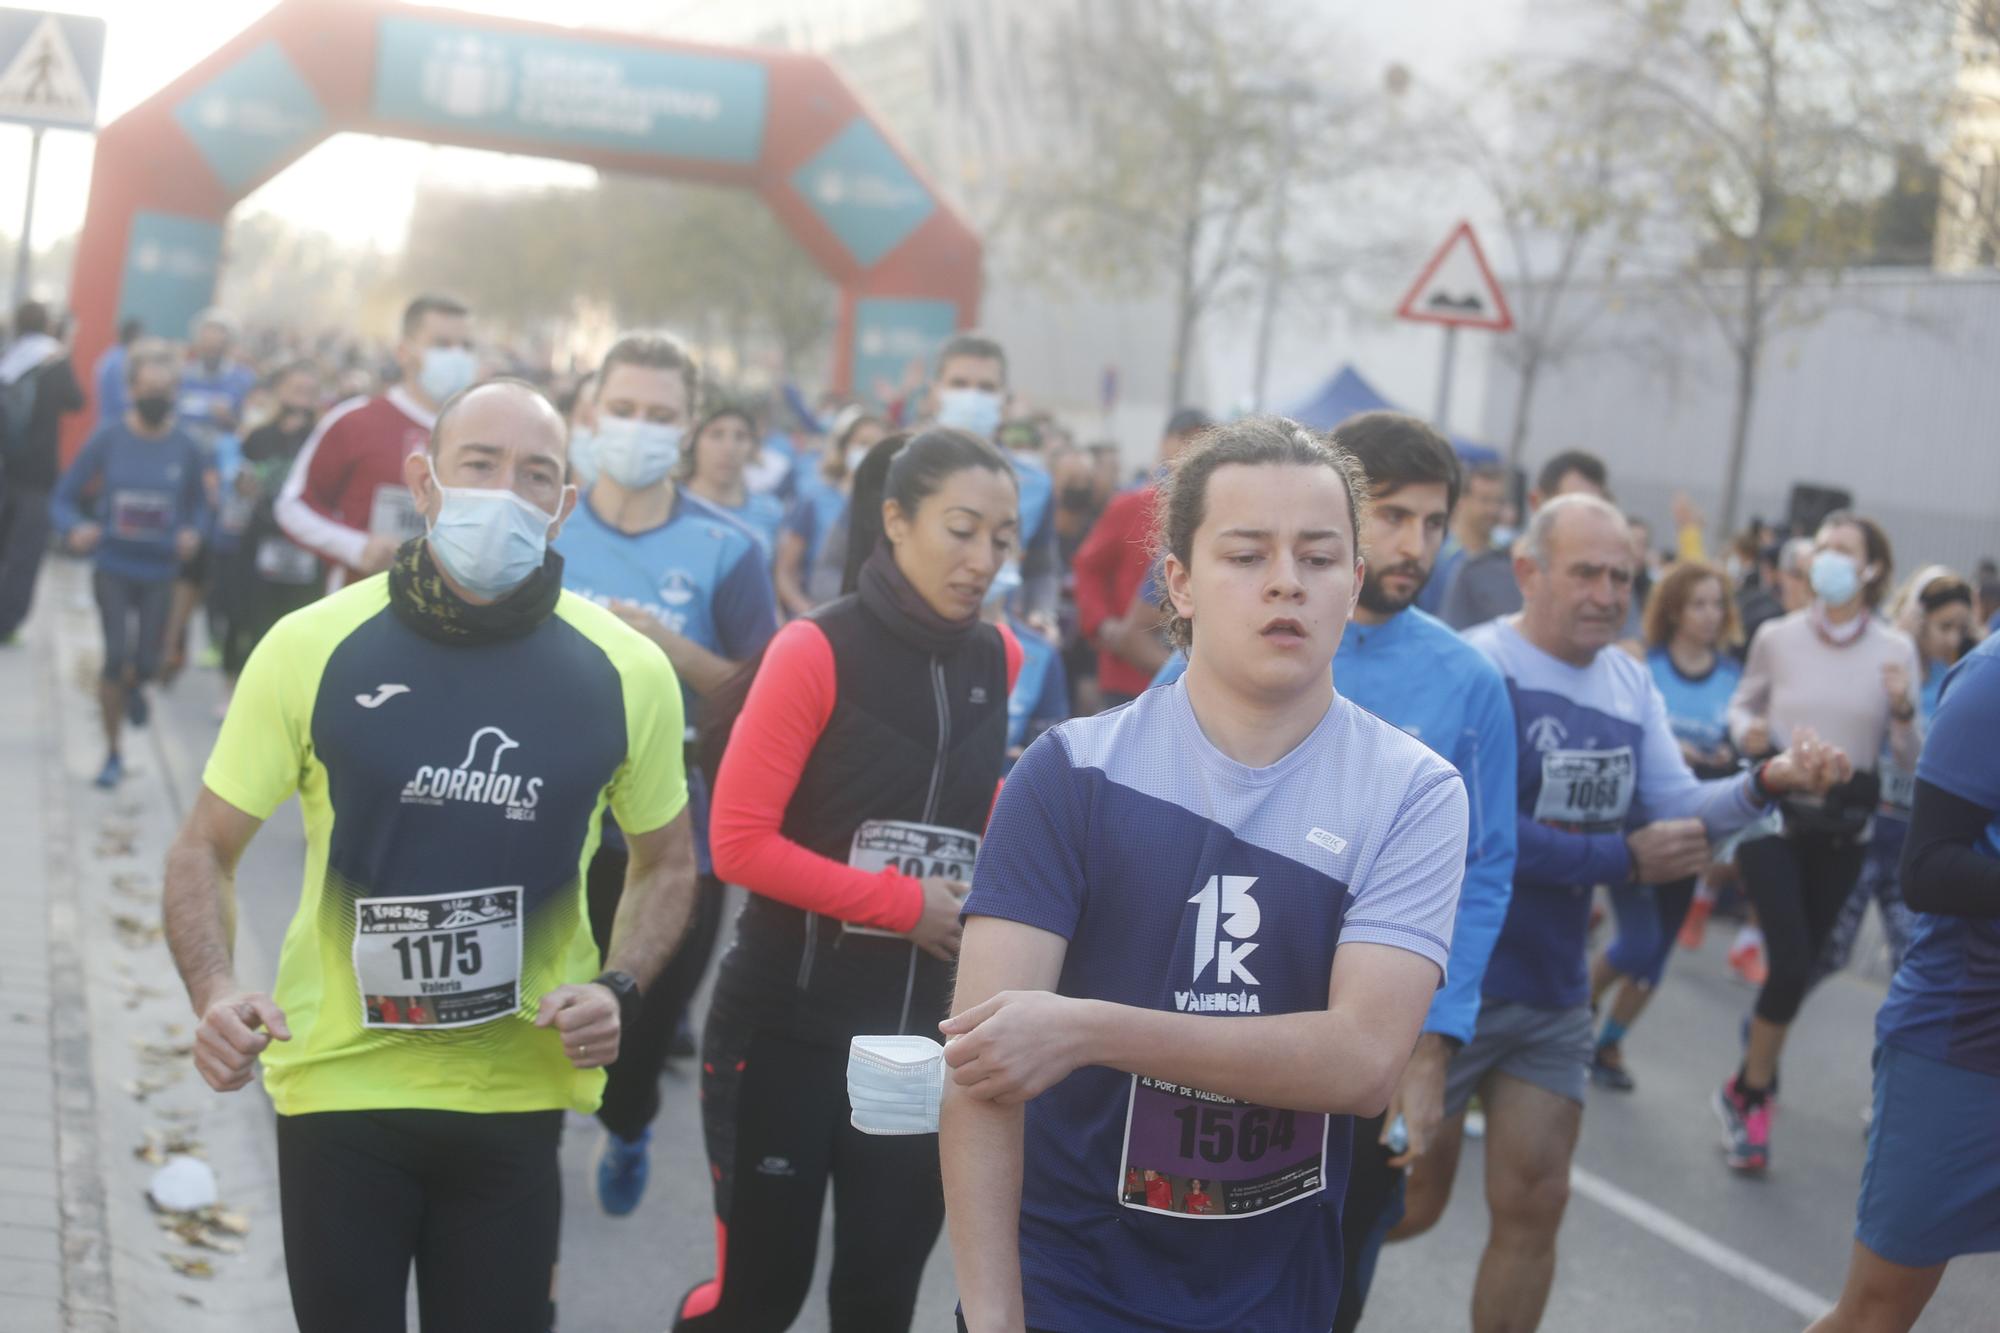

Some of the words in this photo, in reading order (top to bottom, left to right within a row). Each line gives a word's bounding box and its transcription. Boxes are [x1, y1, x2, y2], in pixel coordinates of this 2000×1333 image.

[414, 765, 544, 808] CORRIOLS
[392, 931, 483, 980] 1175
[1142, 1077, 1152, 1087] AL
[1154, 1080, 1177, 1093] PORT
[1180, 1087, 1192, 1097] DE
[1175, 1104, 1296, 1163] 1564
